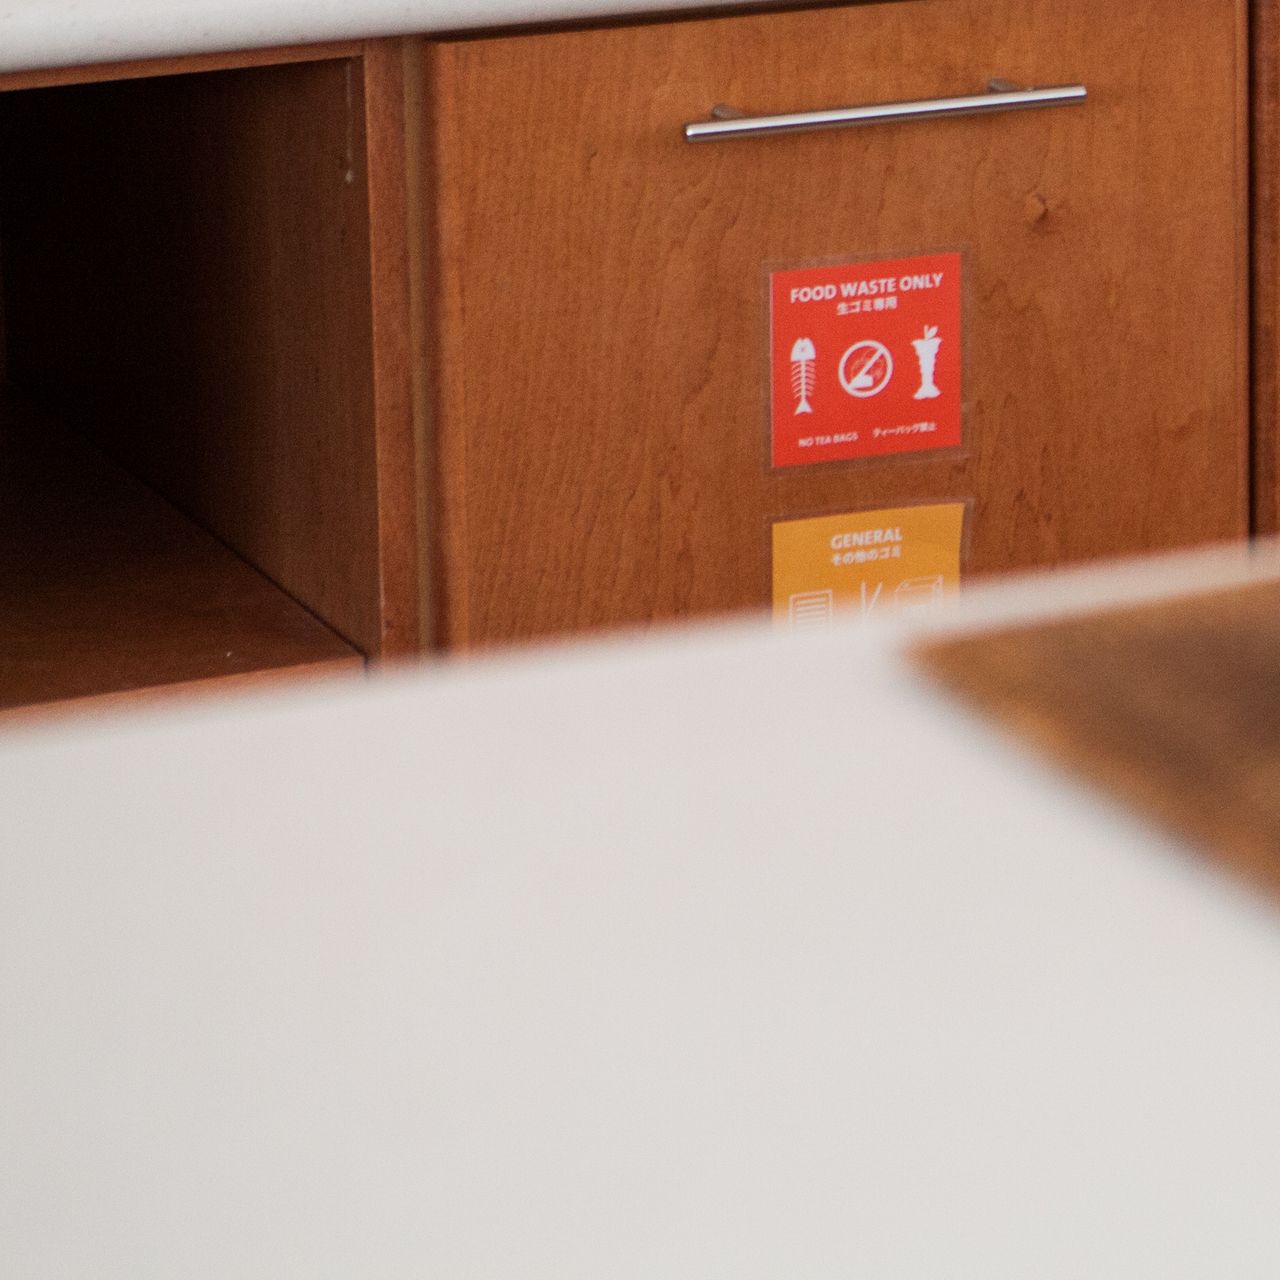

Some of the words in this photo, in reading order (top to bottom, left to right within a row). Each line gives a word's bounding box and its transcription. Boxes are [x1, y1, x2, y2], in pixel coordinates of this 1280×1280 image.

[790, 284, 837, 304] FOOD
[840, 277, 897, 298] WASTE
[899, 272, 944, 292] ONLY
[815, 435, 831, 446] TEA
[833, 431, 859, 443] BAGS
[831, 527, 903, 550] GENERAL
